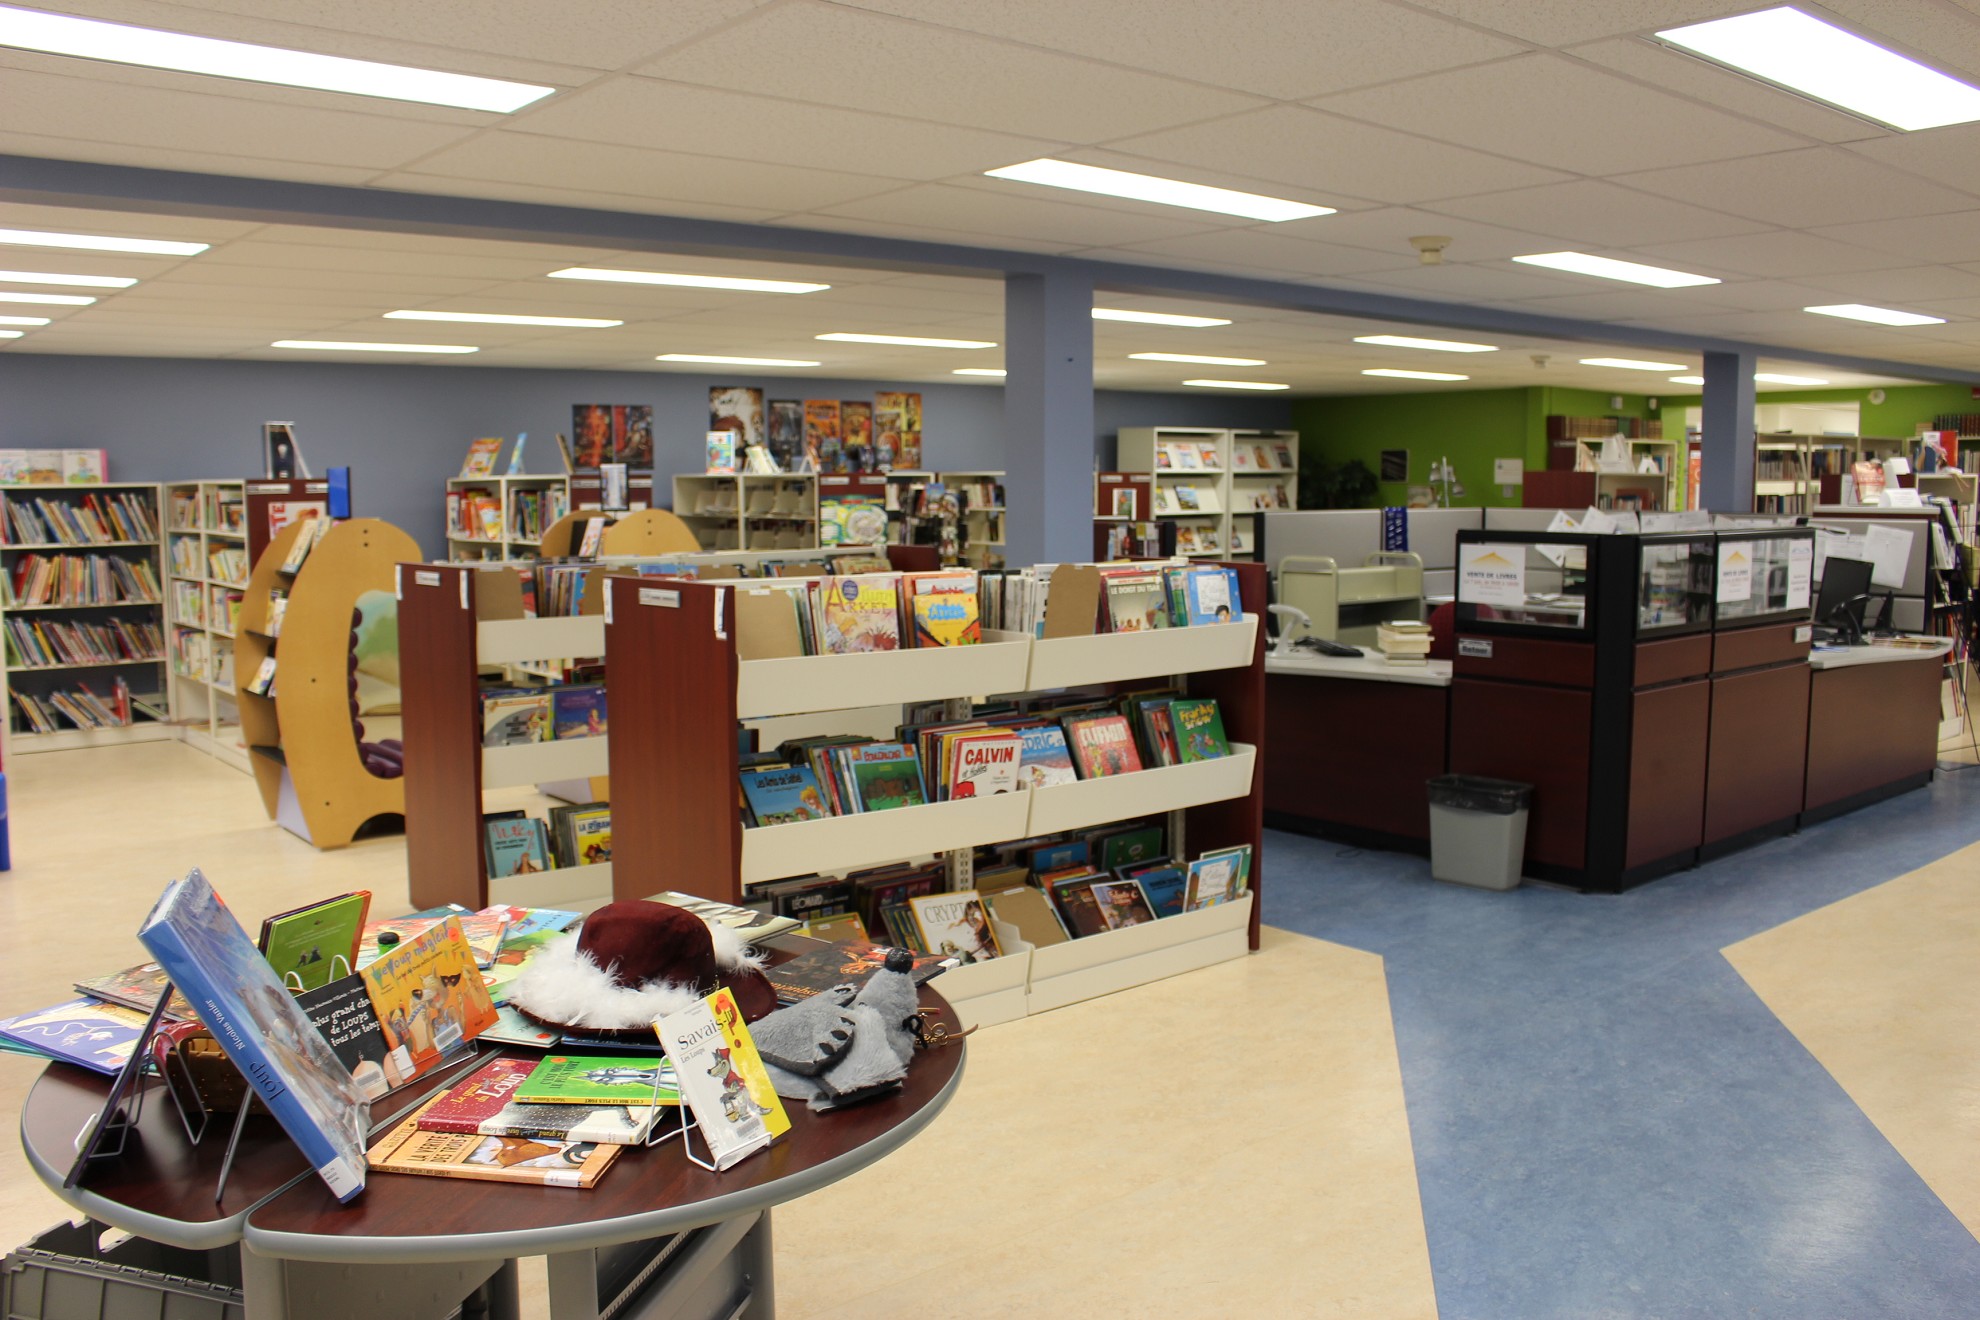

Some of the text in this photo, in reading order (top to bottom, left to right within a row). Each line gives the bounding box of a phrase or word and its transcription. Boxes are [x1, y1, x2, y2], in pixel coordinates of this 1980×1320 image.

[965, 747, 1014, 766] CALVIN
[205, 999, 226, 1024] Vanier
[331, 1002, 355, 1025] grand
[330, 1012, 369, 1035] de LOUPS
[223, 1021, 246, 1050] Nicolas
[331, 1033, 349, 1047] tous
